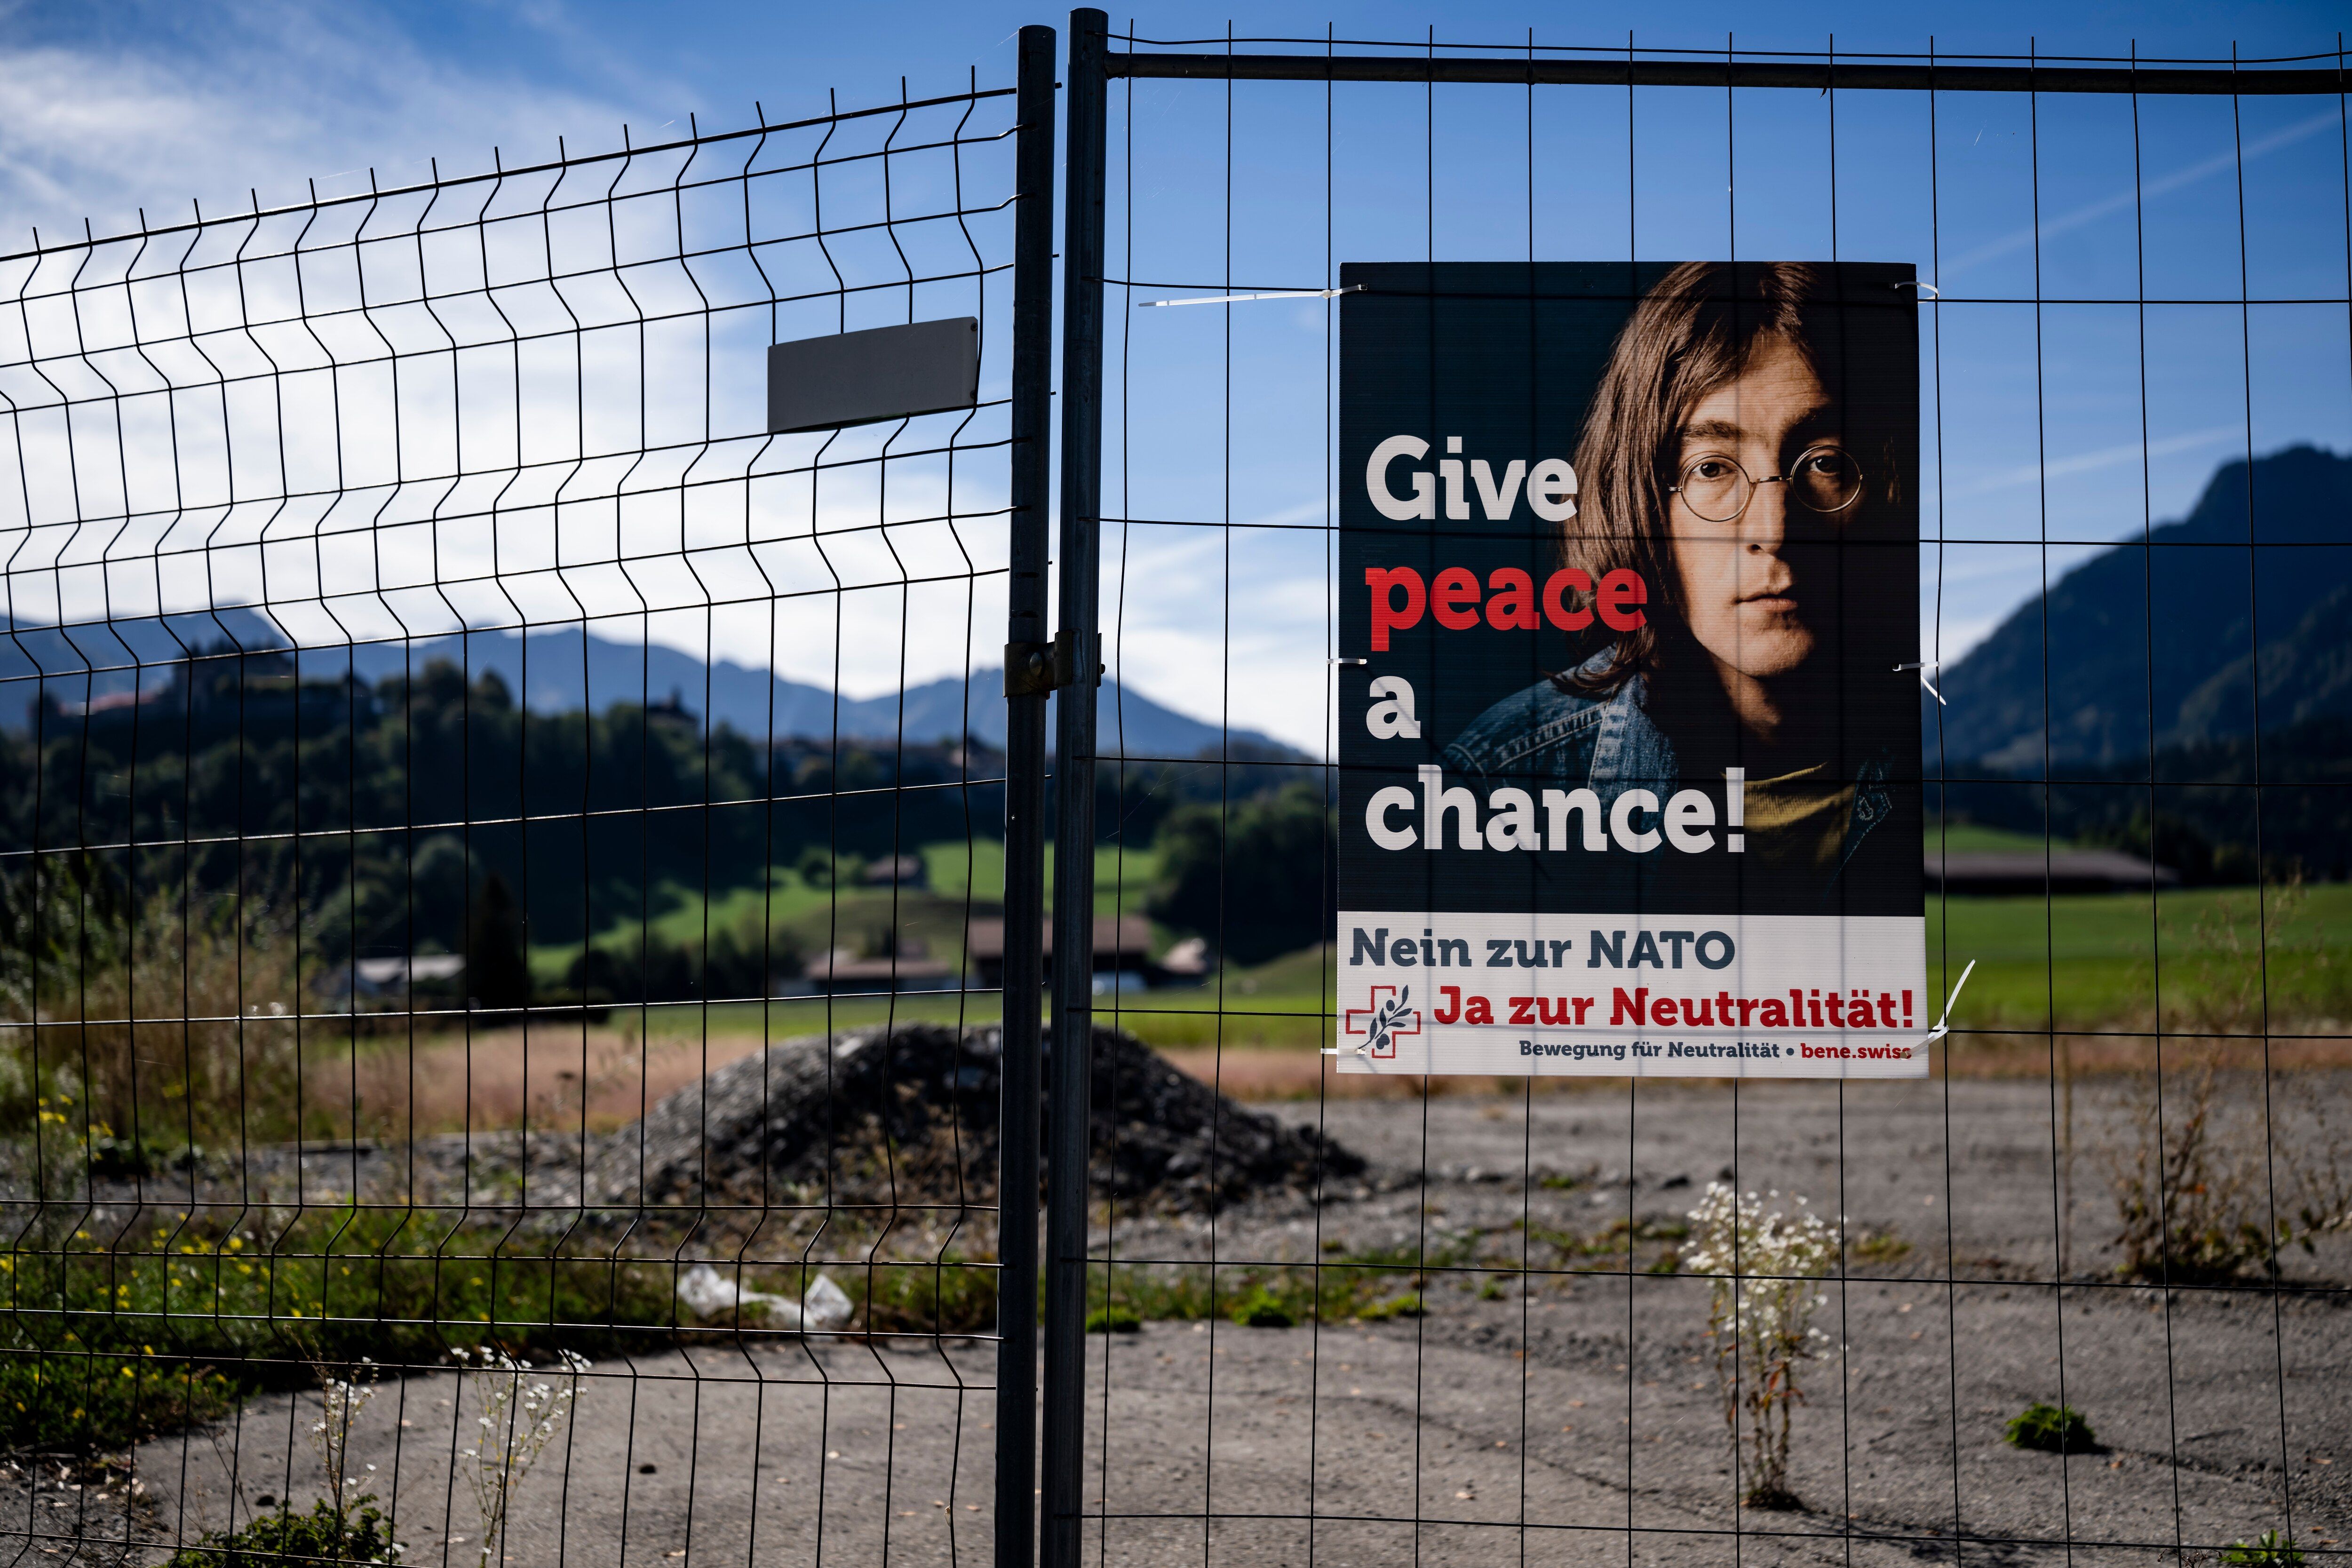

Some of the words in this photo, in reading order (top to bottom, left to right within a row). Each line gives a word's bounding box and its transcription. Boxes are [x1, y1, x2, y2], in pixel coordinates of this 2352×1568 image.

[1366, 435, 1578, 522] Give
[1365, 566, 1647, 652] peace
[1366, 676, 1421, 740] a
[1366, 764, 1745, 853] chance!
[1350, 928, 1472, 967] Nein
[1486, 939, 1572, 968] zur
[1587, 930, 1735, 970] NATO
[1434, 986, 1494, 1025] Ja
[1509, 996, 1594, 1026] zur
[1610, 987, 1913, 1028] Neutralität!
[1519, 1040, 1626, 1061] Bewegung
[1631, 1041, 1662, 1057] für
[1668, 1042, 1780, 1058] Neutralität
